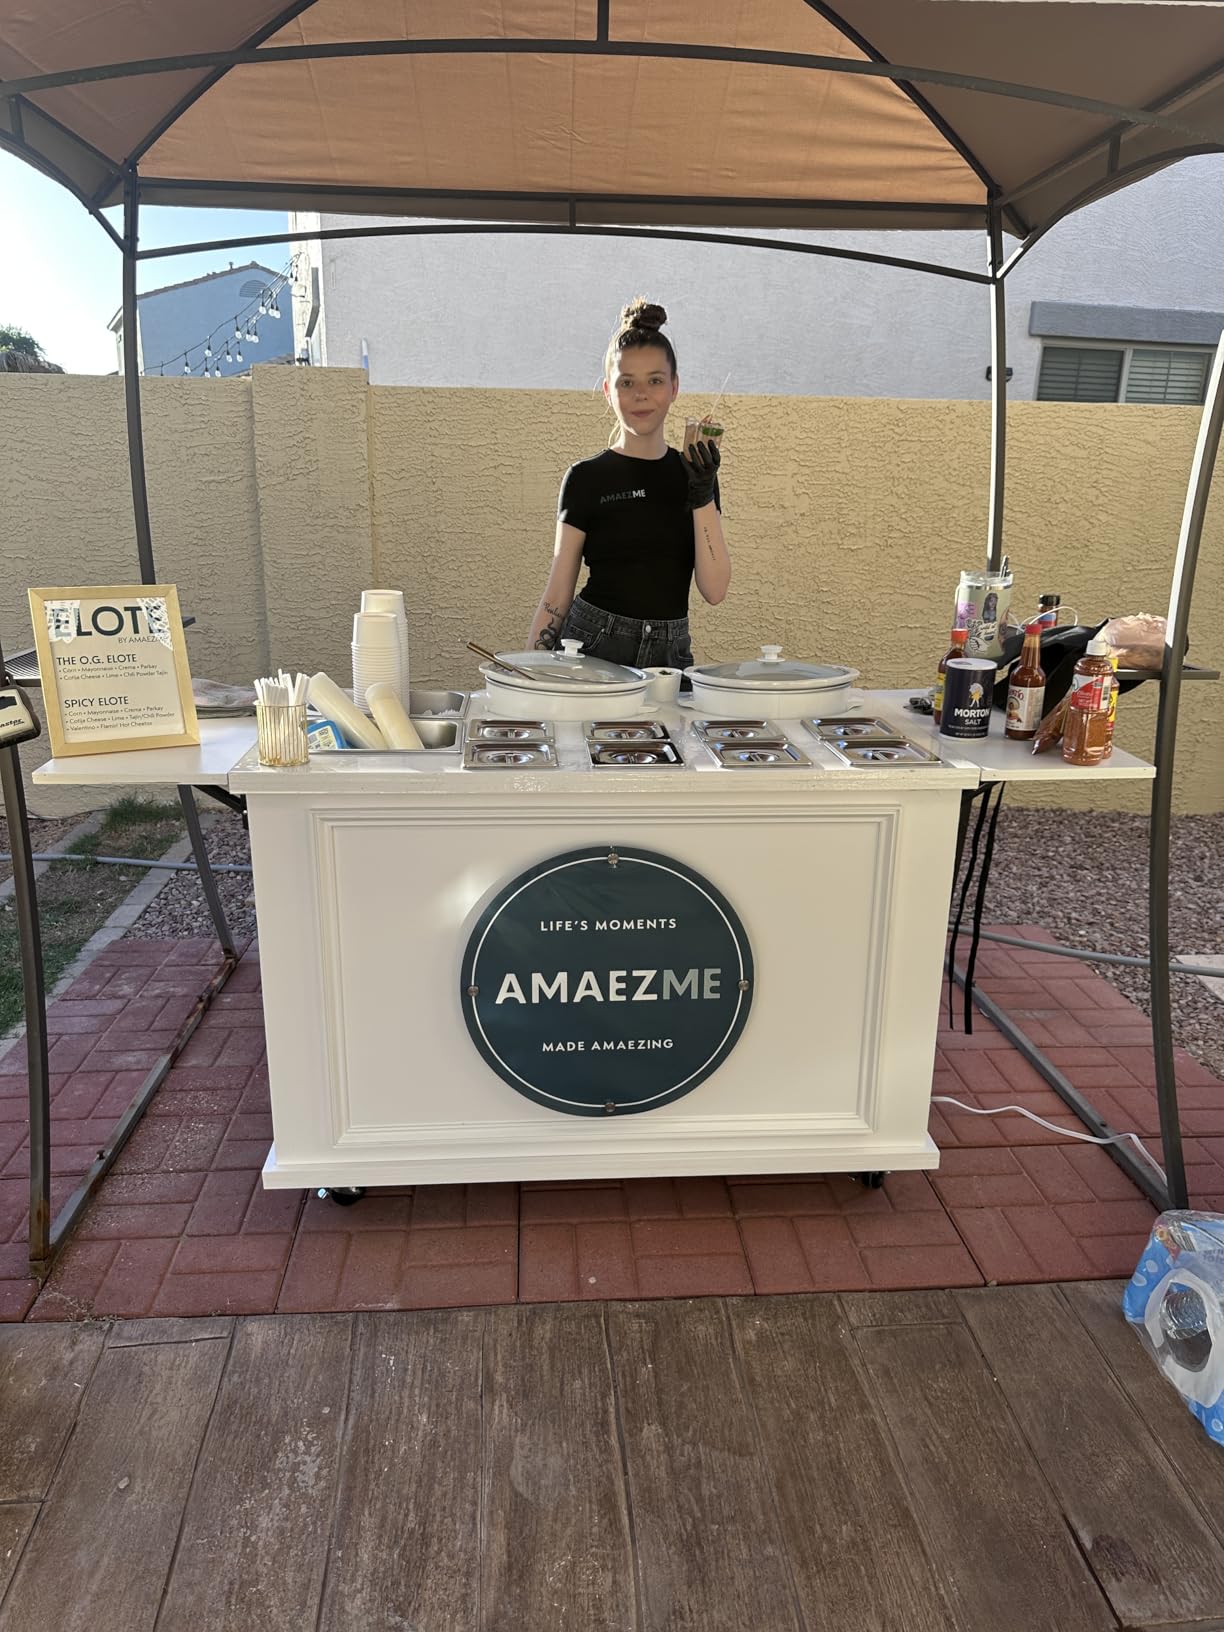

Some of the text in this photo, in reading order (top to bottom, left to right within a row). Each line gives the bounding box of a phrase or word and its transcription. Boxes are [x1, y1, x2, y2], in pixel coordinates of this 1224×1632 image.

[600, 489, 646, 504] AMAEZME
[56, 653, 138, 665] THE O.G. ELOTE
[64, 696, 129, 708] SPICY ELOTE
[954, 708, 990, 717] MORTON
[540, 918, 677, 932] LIFE'S MOMENTS
[495, 968, 722, 1005] AMAEZME
[542, 1039, 673, 1052] MADE AMAEZING
